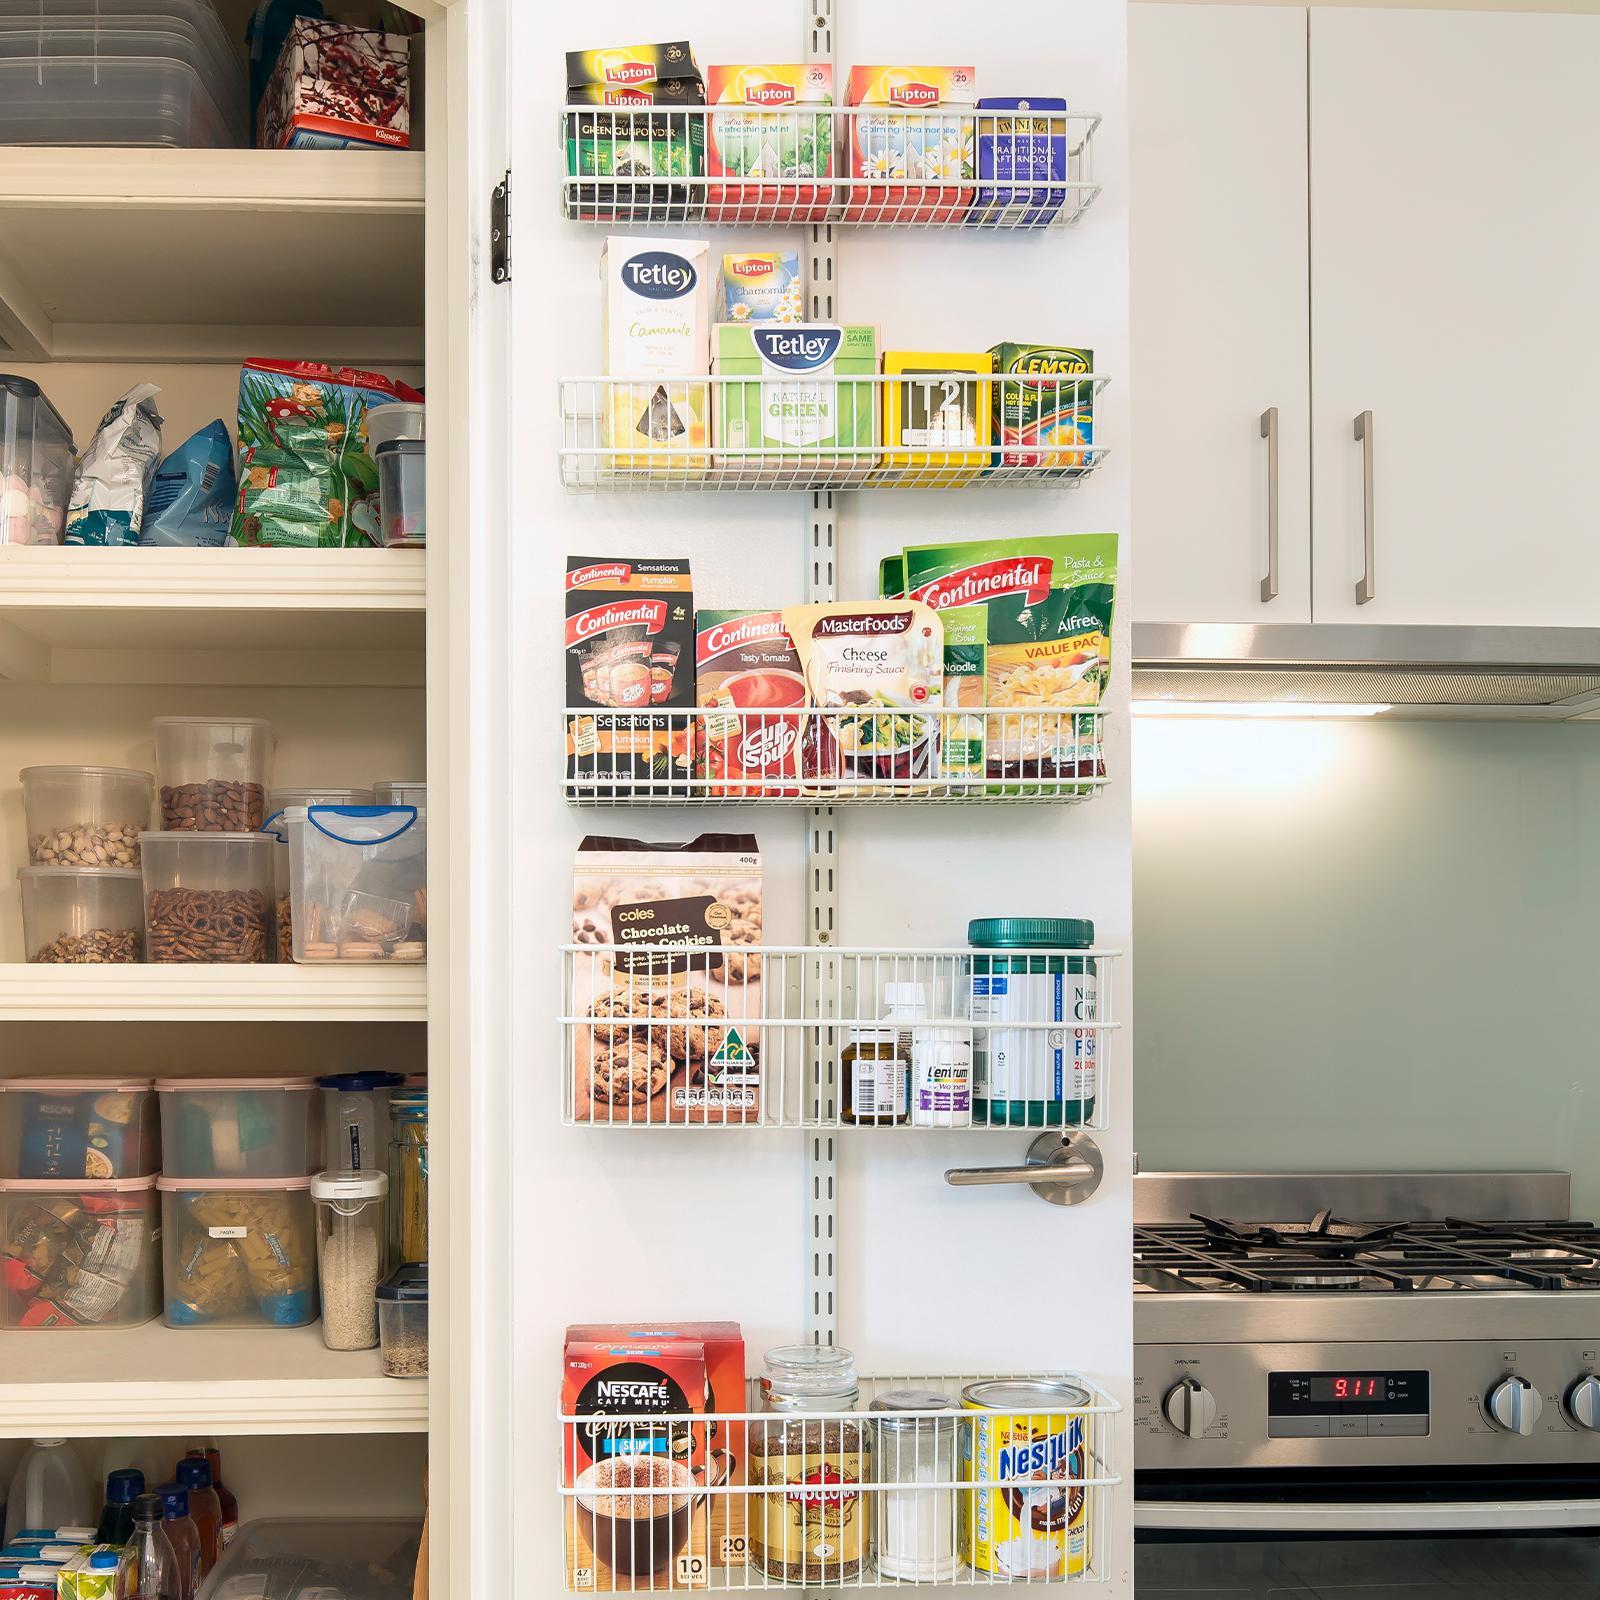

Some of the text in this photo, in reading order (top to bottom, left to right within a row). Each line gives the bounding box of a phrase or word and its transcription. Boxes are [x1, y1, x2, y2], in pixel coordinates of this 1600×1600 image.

[669, 50, 681, 59] 20
[608, 66, 652, 81] Lipton
[812, 72, 823, 80] 20
[956, 74, 967, 83] 20
[607, 91, 650, 106] Lipton
[748, 87, 792, 102] Lipton
[893, 87, 936, 102] Lipton
[769, 125, 789, 133] Mnt
[735, 262, 771, 275] Lipton
[627, 261, 692, 292] Tetley
[735, 285, 791, 297] Chamomile
[629, 320, 692, 337] Camomile
[766, 333, 831, 362] Tetley
[1016, 358, 1087, 374] LEMSIP
[916, 380, 961, 412] T2
[768, 403, 829, 417] GREEN
[637, 563, 679, 572] Sensations
[1064, 555, 1104, 568] Pasta &
[571, 566, 626, 585] Continental
[642, 576, 676, 585] Pumpkin
[1072, 570, 1105, 582] Sauce
[921, 563, 1040, 609] Continental
[673, 606, 686, 616] 4x
[575, 603, 660, 636] Continental
[821, 614, 906, 633] MasterFoods
[842, 647, 888, 661] Cheese
[1025, 635, 1100, 659] VALUE PAC
[740, 653, 791, 663] Tasty Tomato
[827, 661, 905, 677] Finishing Sauce
[943, 661, 977, 671] Noodle
[597, 715, 665, 727] Sensations
[739, 856, 758, 864] 400g
[618, 908, 655, 922] coles
[620, 923, 690, 940] Chocolate
[659, 934, 714, 947] Cookies
[998, 1415, 1085, 1481] Nesquik
[723, 1537, 746, 1552] 20
[680, 1558, 703, 1574] 10
